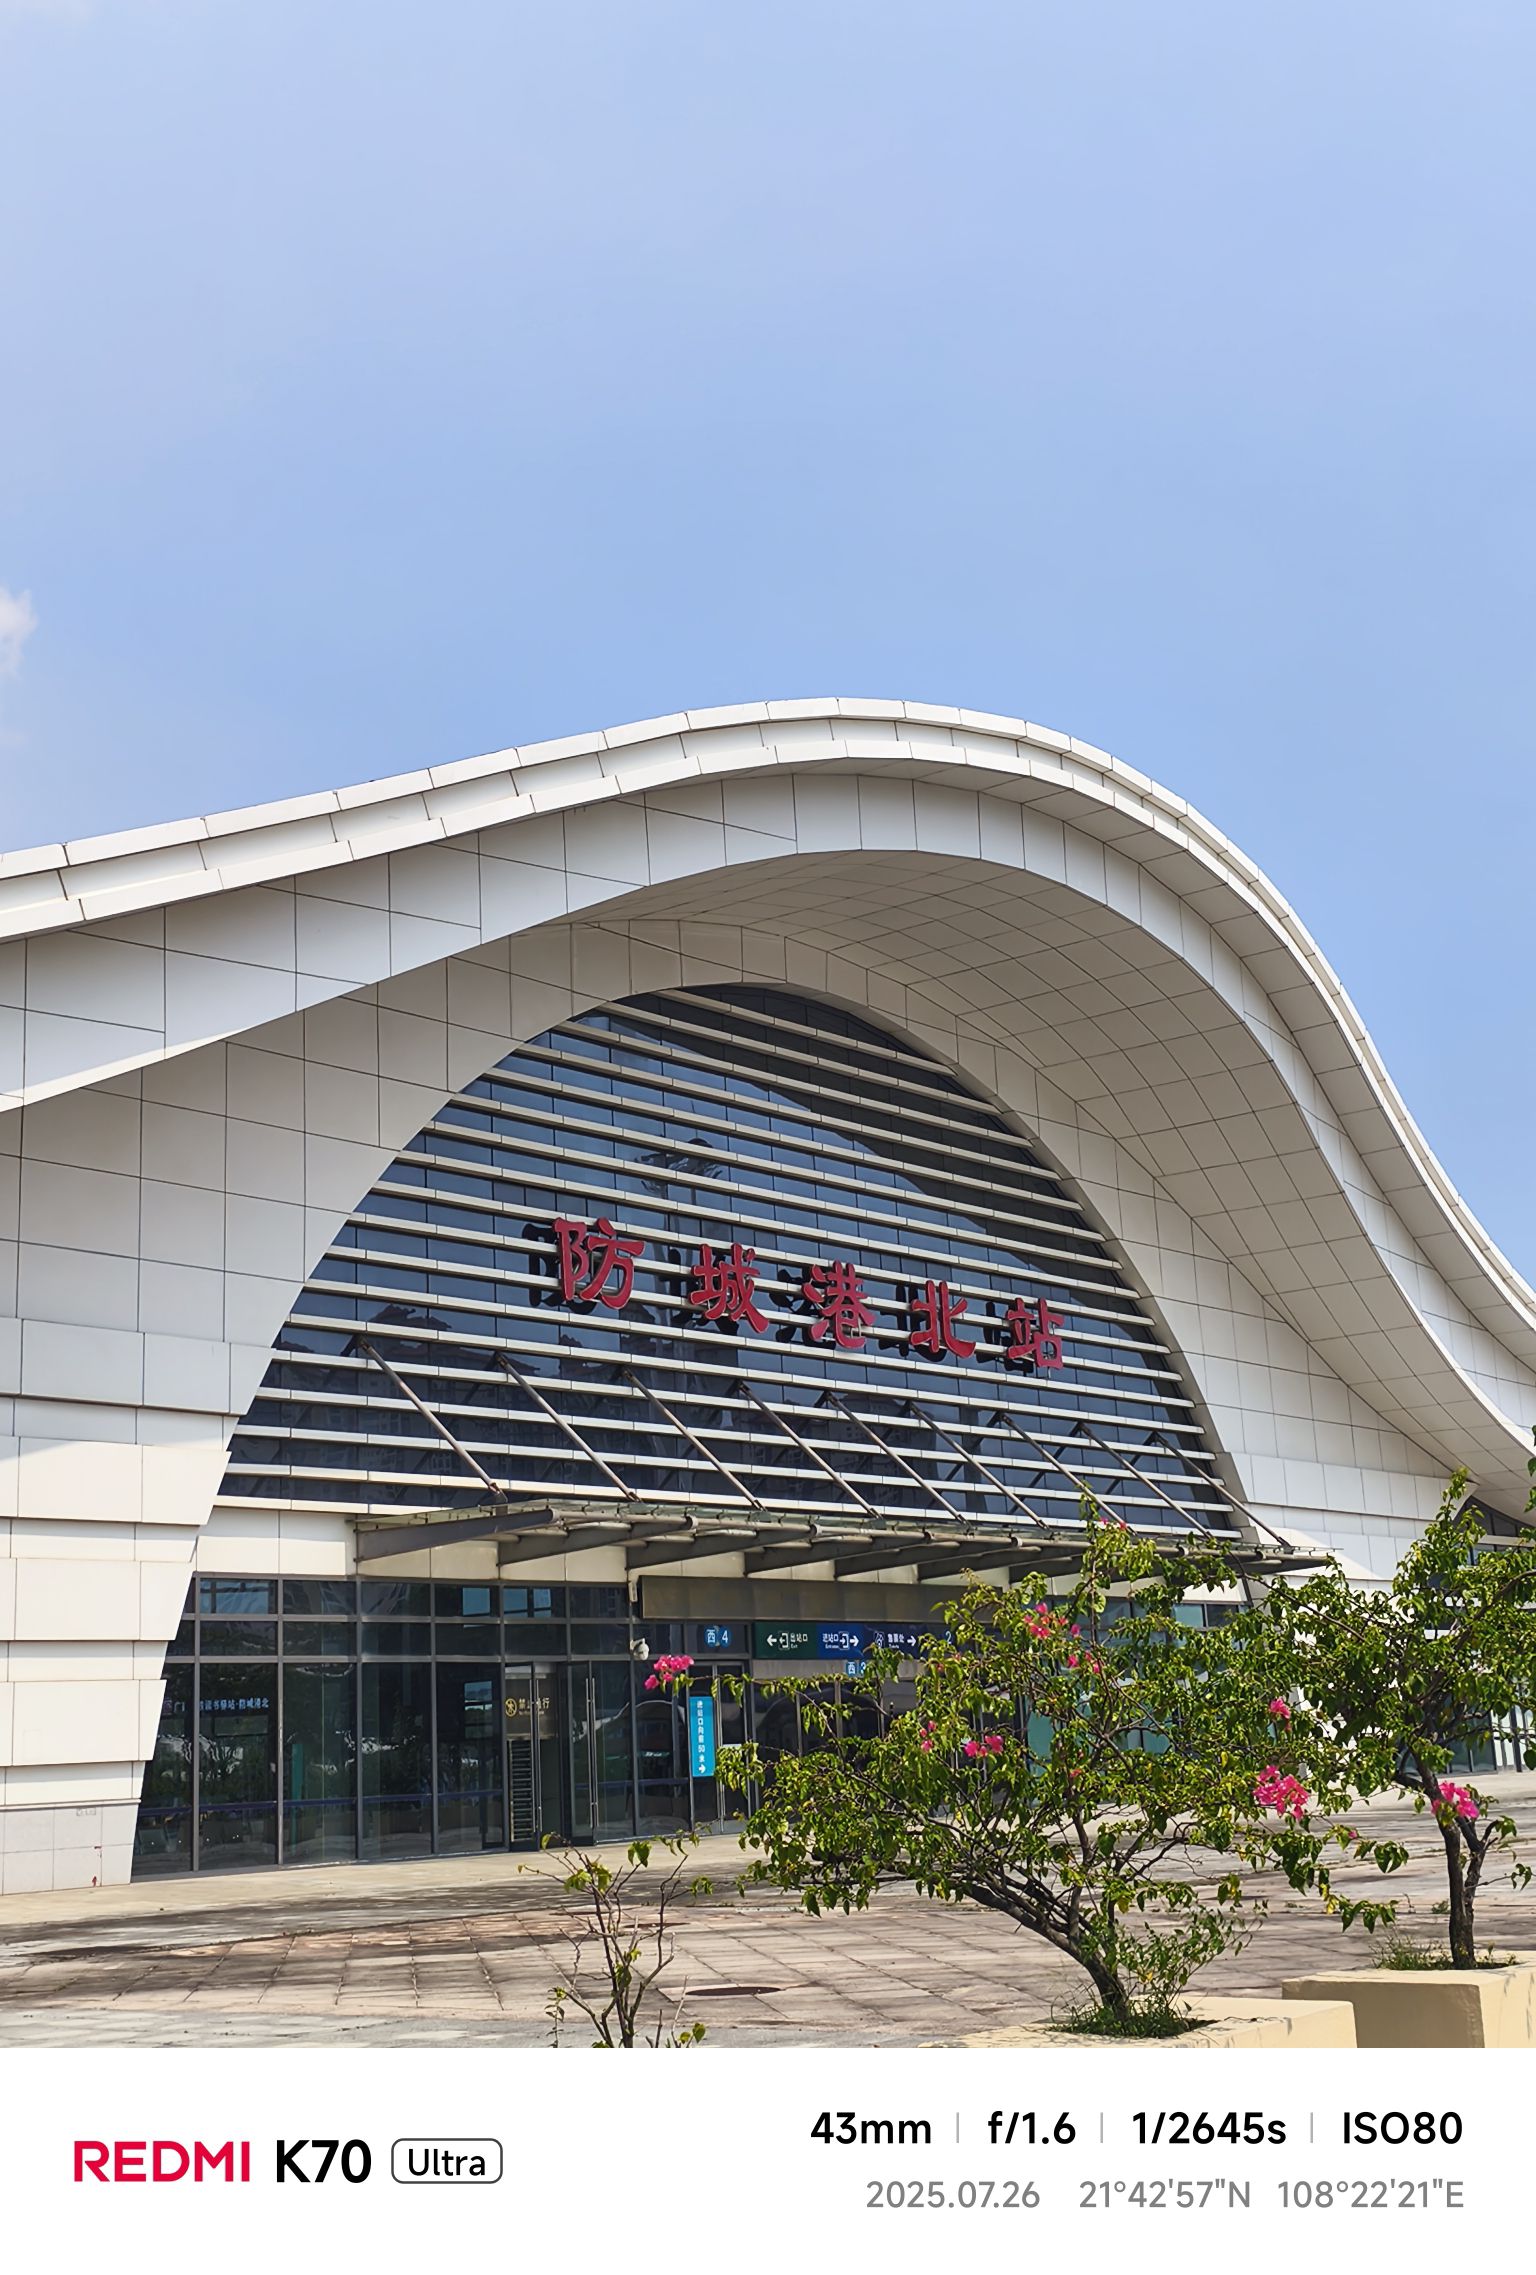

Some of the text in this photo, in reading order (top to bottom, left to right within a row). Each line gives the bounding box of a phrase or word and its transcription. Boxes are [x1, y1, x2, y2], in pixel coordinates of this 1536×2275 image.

[552, 1217, 1064, 1369] 防城港北站
[790, 1632, 808, 1643] 出站口
[822, 1632, 839, 1643] 进站口
[887, 1633, 905, 1643] 售票处
